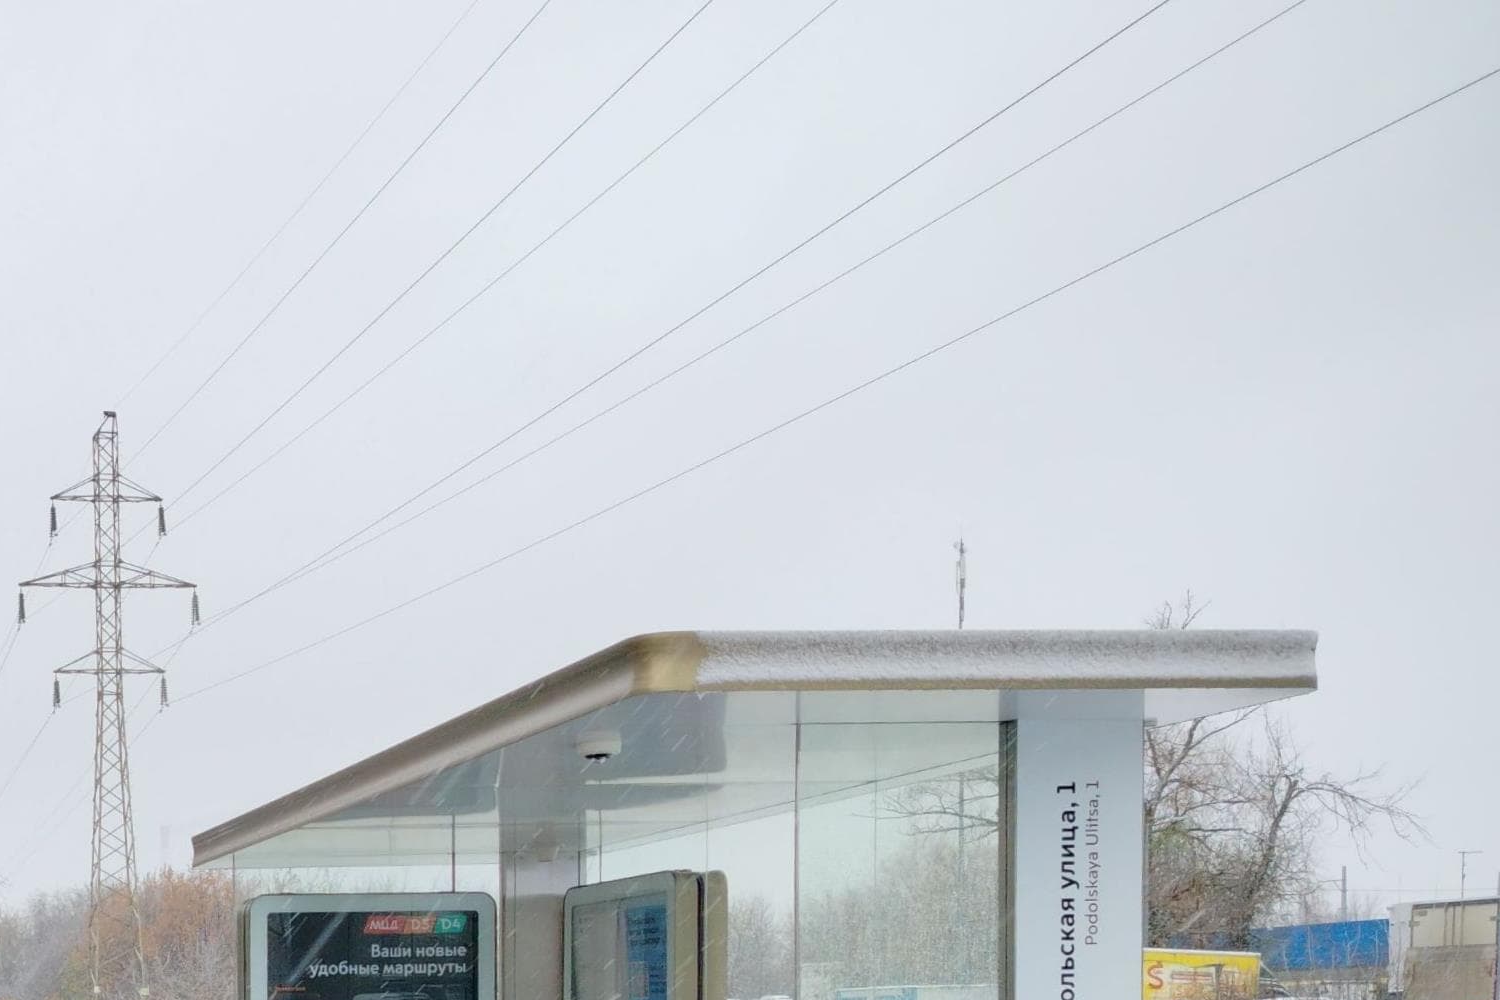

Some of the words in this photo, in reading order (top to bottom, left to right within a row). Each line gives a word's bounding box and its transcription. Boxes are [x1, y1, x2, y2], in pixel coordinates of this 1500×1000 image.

[1057, 781, 1076, 794] 1
[1086, 780, 1099, 789] 1
[1085, 794, 1101, 846] Ulitsa,
[1061, 802, 1080, 889] улица,
[1084, 851, 1101, 945] Podolskaya
[441, 918, 461, 930] D4
[371, 944, 412, 958] Ваши
[416, 945, 467, 957] новые
[309, 961, 379, 978] удобные
[382, 962, 467, 977] маршруты
